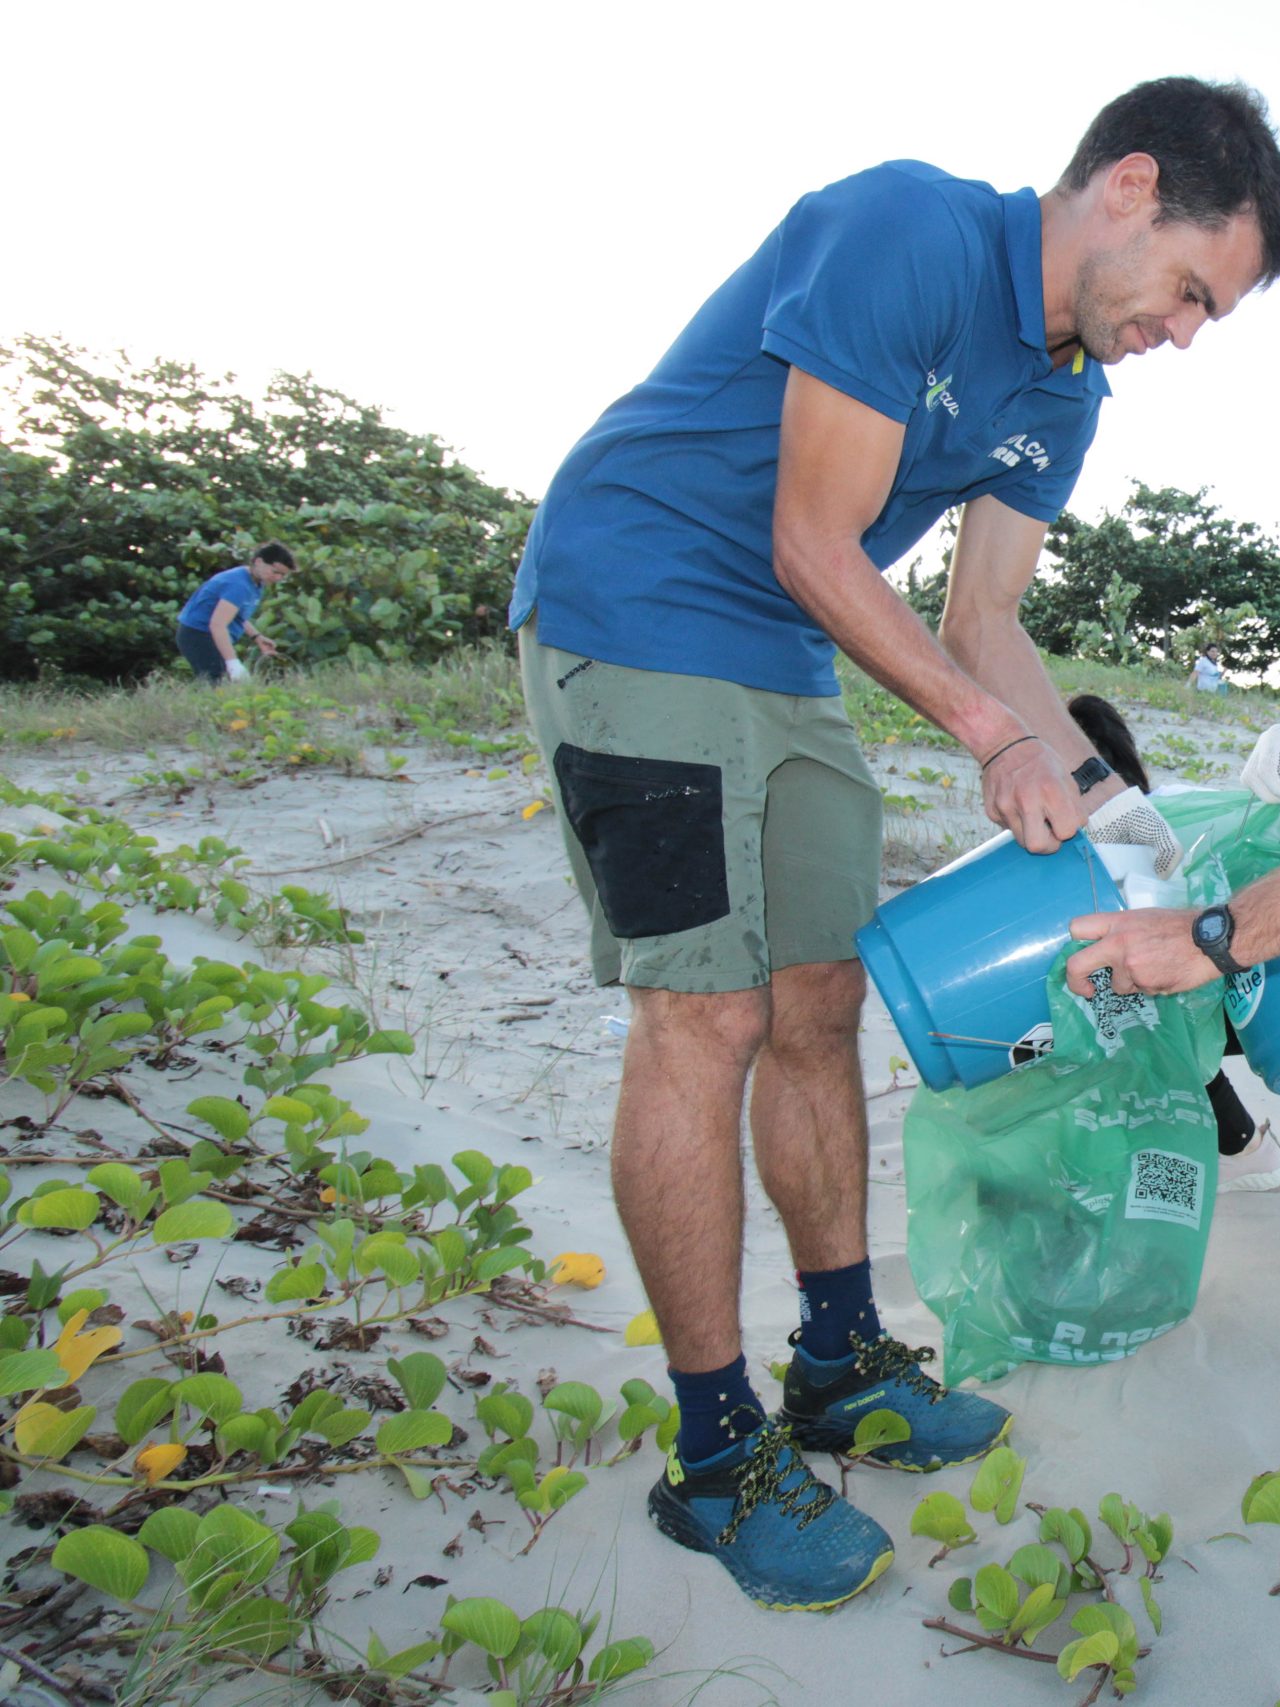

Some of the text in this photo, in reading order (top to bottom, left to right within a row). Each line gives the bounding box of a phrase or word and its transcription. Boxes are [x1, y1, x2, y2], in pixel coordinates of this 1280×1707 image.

[1228, 971, 1262, 1009] blue
[1053, 1321, 1086, 1345] A
[843, 1390, 886, 1412] new balance
